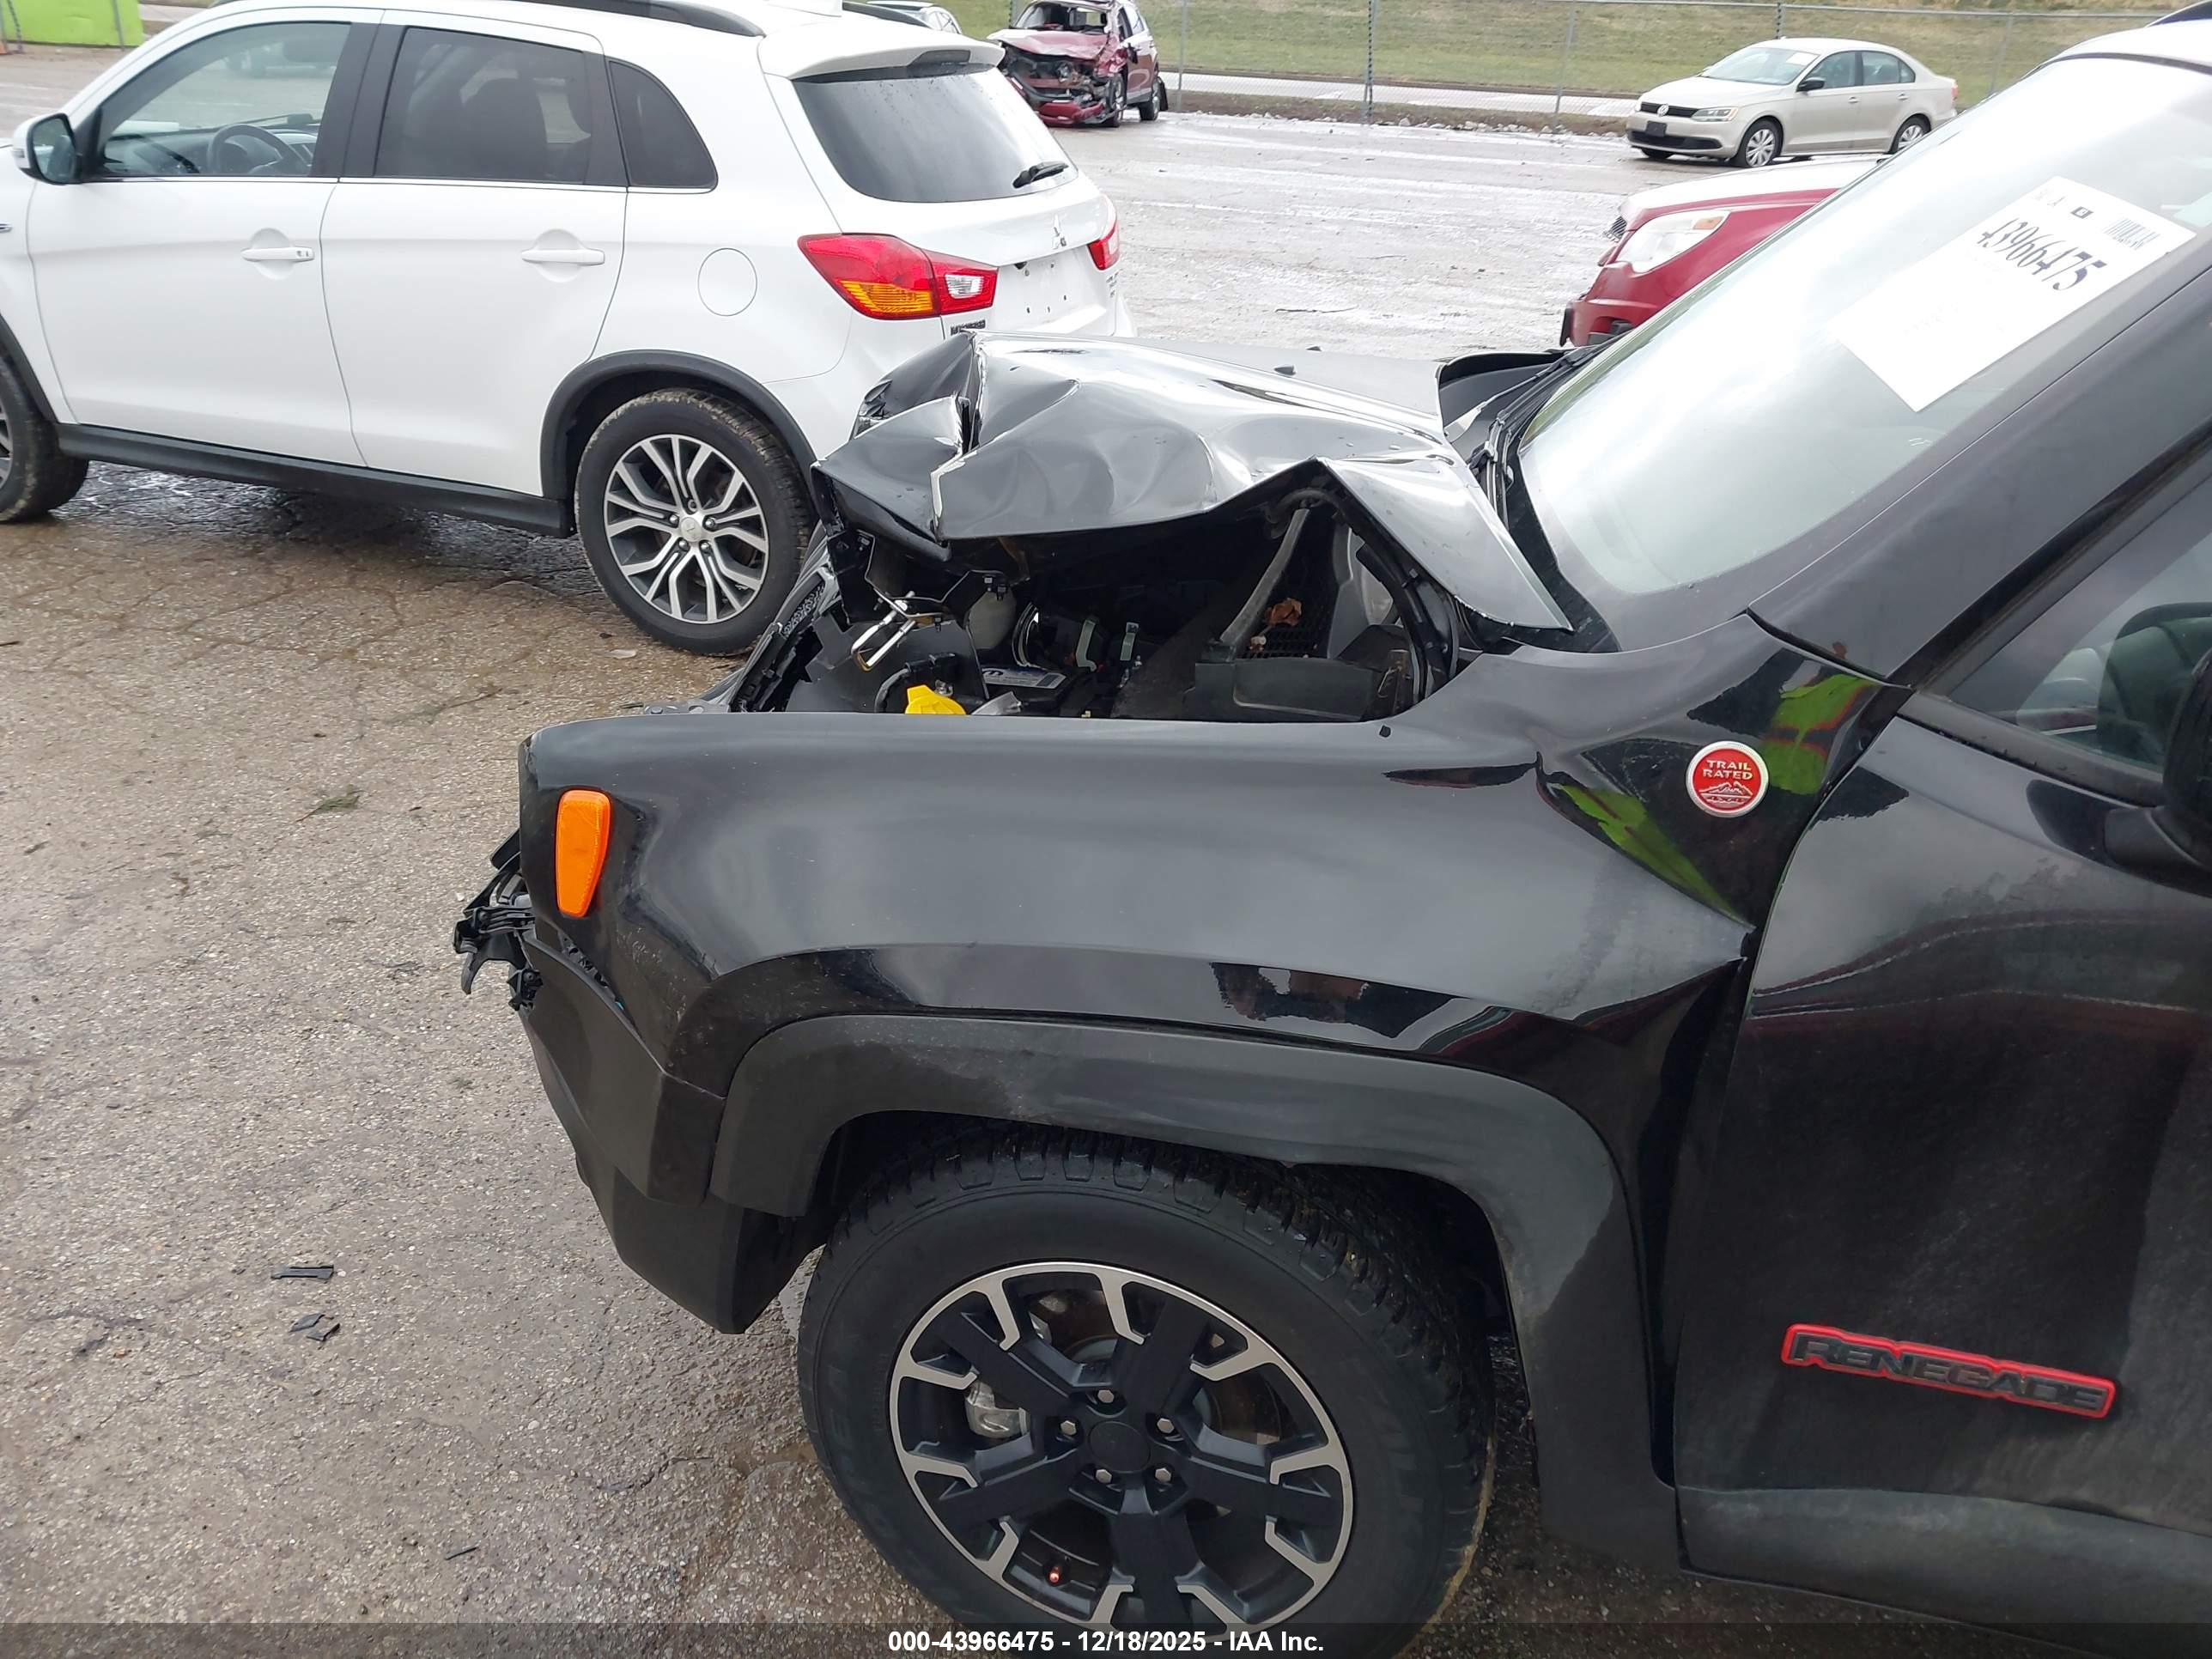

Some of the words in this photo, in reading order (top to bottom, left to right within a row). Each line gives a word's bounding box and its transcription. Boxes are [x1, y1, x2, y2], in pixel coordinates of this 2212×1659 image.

[1977, 218, 2107, 290] 43966475
[1703, 769, 1753, 781] RATED
[1706, 760, 1752, 771] TRAIL
[1791, 1332, 2109, 1411] RENEGADE
